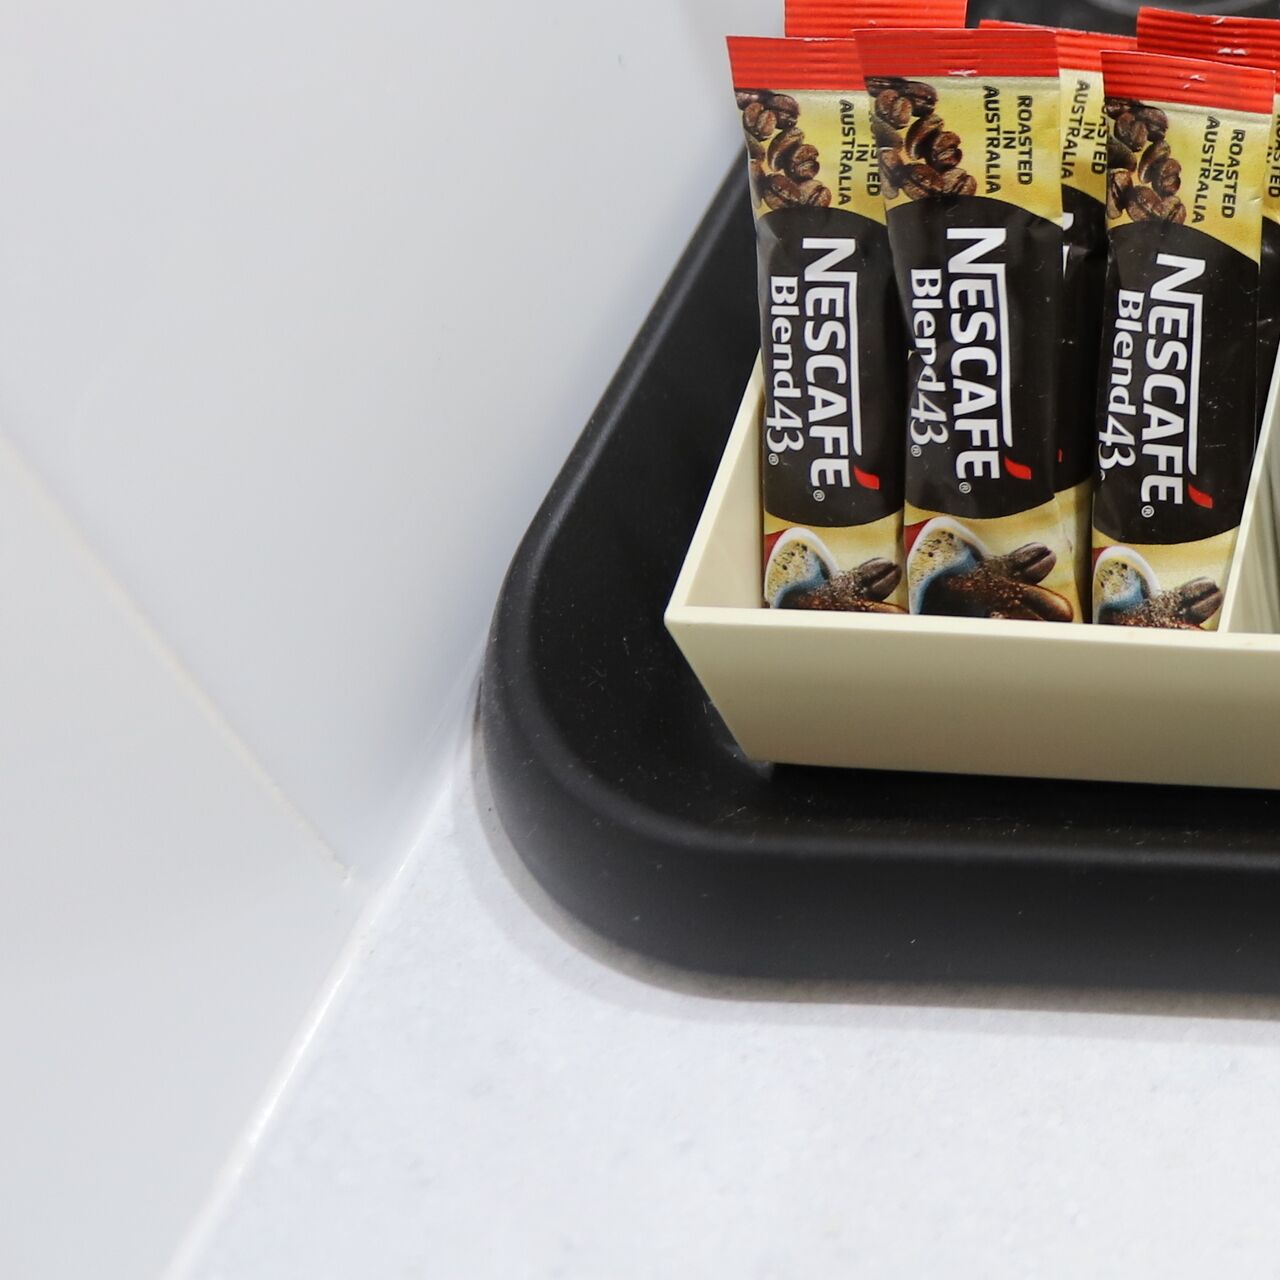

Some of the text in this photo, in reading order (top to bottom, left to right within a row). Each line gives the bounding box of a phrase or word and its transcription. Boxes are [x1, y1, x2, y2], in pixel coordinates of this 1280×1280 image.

[838, 99, 856, 205] AUSTRALIA
[856, 143, 869, 162] IN
[982, 86, 1001, 195] AUSTRALIA
[1002, 130, 1016, 150] IN
[1016, 95, 1033, 186] ROASTED
[1060, 79, 1091, 179] AUSTRALIA
[1082, 122, 1097, 140] IN
[1192, 115, 1221, 224] AUSTRALIA
[1208, 162, 1223, 183] IN
[1221, 128, 1246, 220] ROASTED
[770, 276, 802, 398] Blend
[911, 268, 946, 391] Blend
[1108, 288, 1145, 415] Blend
